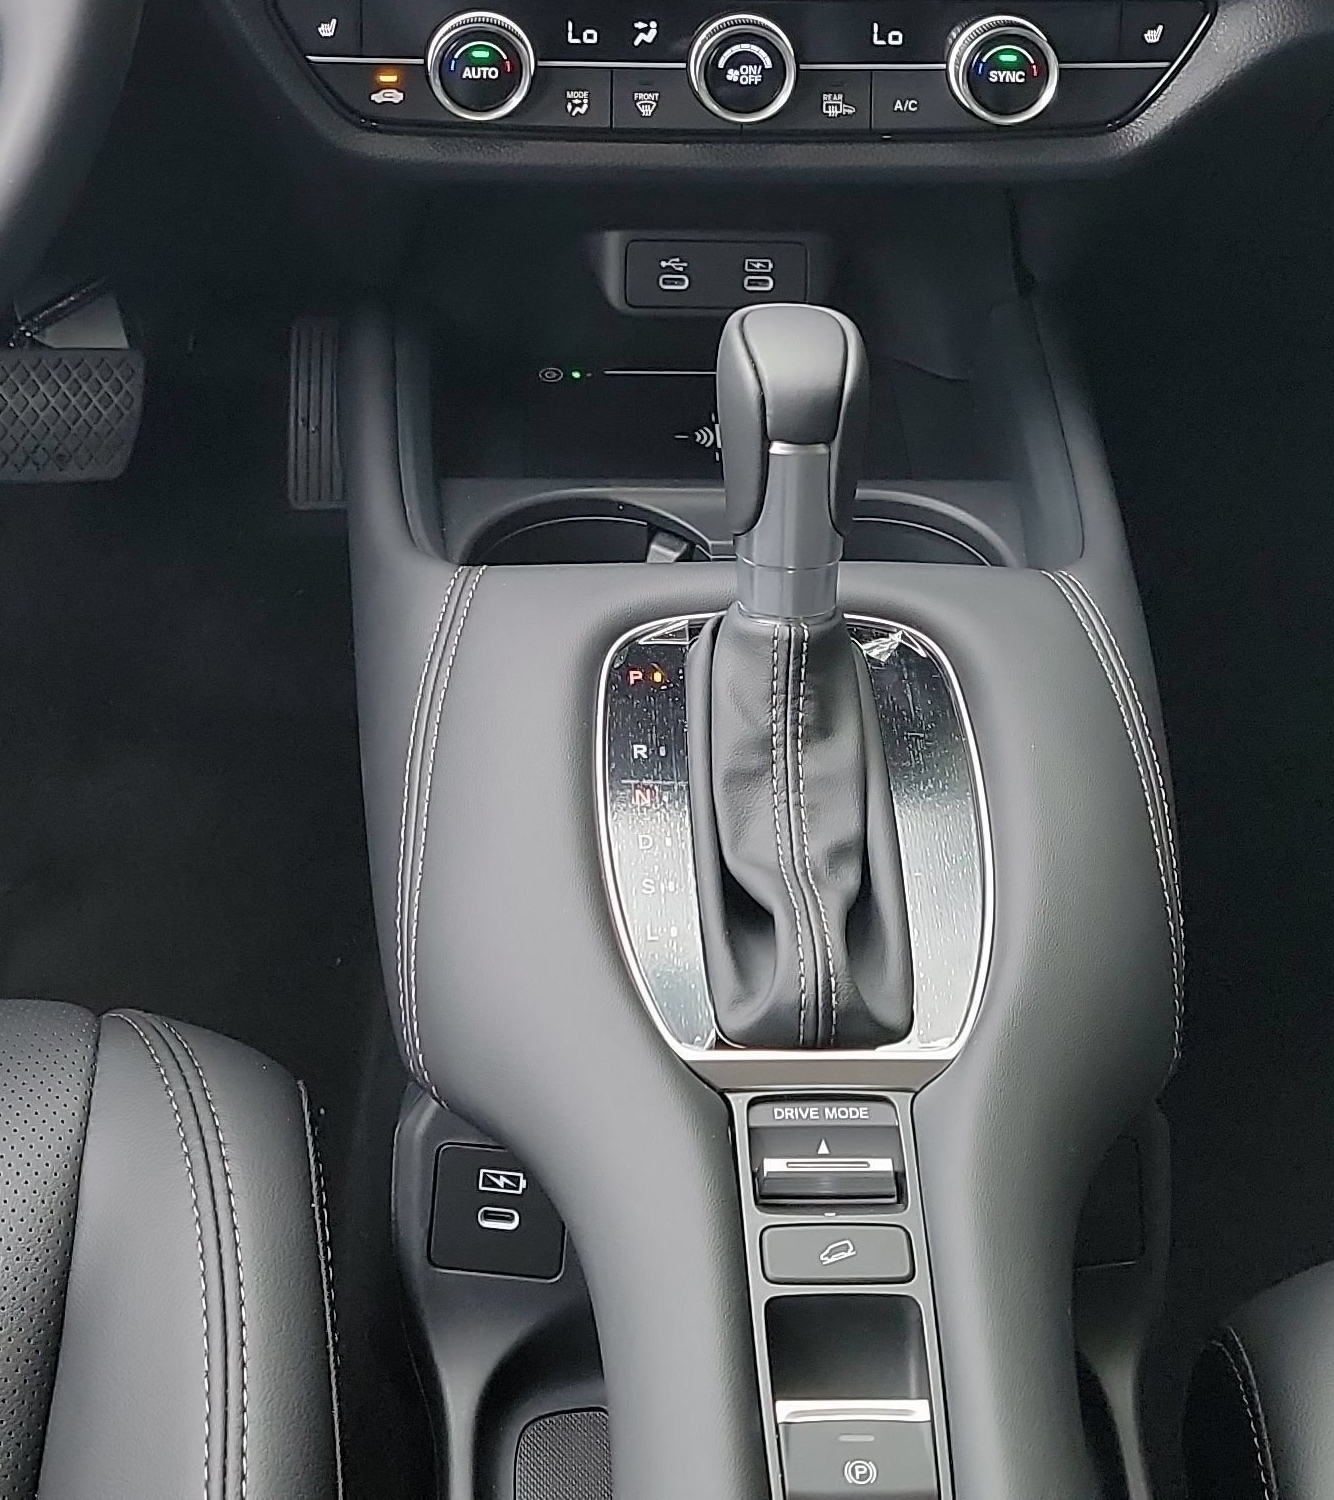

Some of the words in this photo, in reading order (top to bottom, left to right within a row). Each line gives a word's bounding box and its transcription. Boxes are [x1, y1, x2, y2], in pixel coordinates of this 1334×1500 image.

[566, 19, 598, 45] Lo
[872, 21, 904, 47] Lo
[462, 66, 499, 81] AUTO
[739, 64, 763, 76] ON/
[988, 69, 1026, 84] SYNC
[739, 75, 763, 86] OFF
[566, 91, 589, 100] MODE
[633, 92, 660, 102] FRONT
[822, 93, 844, 102] REAR
[893, 99, 918, 112] A/C
[628, 670, 644, 685] P
[632, 744, 649, 759] R
[633, 788, 653, 804] N
[638, 834, 654, 850] D
[641, 878, 656, 895] S
[647, 924, 660, 941] L
[773, 1107, 820, 1121] DRIVE
[824, 1106, 869, 1120] MODE
